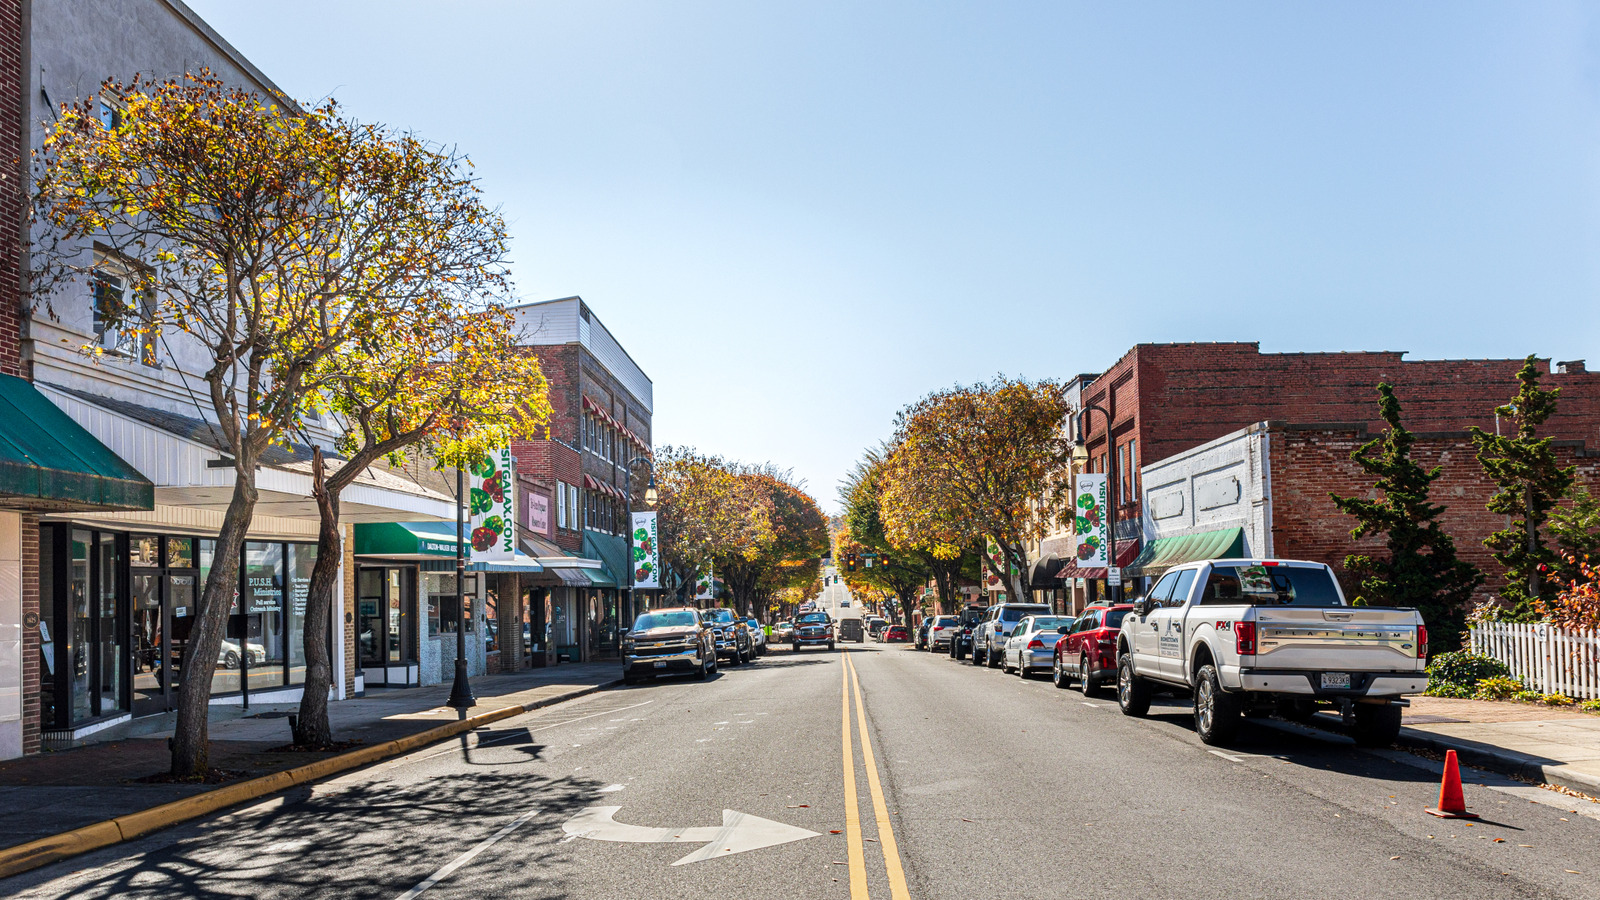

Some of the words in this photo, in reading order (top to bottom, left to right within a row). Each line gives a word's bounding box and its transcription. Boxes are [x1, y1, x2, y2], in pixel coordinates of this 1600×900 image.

[501, 446, 513, 553] SITGALAX.COM
[1099, 481, 1107, 561] VISITGALAX.COM
[253, 587, 282, 596] Ministries
[1216, 621, 1231, 630] FX4
[1275, 630, 1401, 638] PLATINUM
